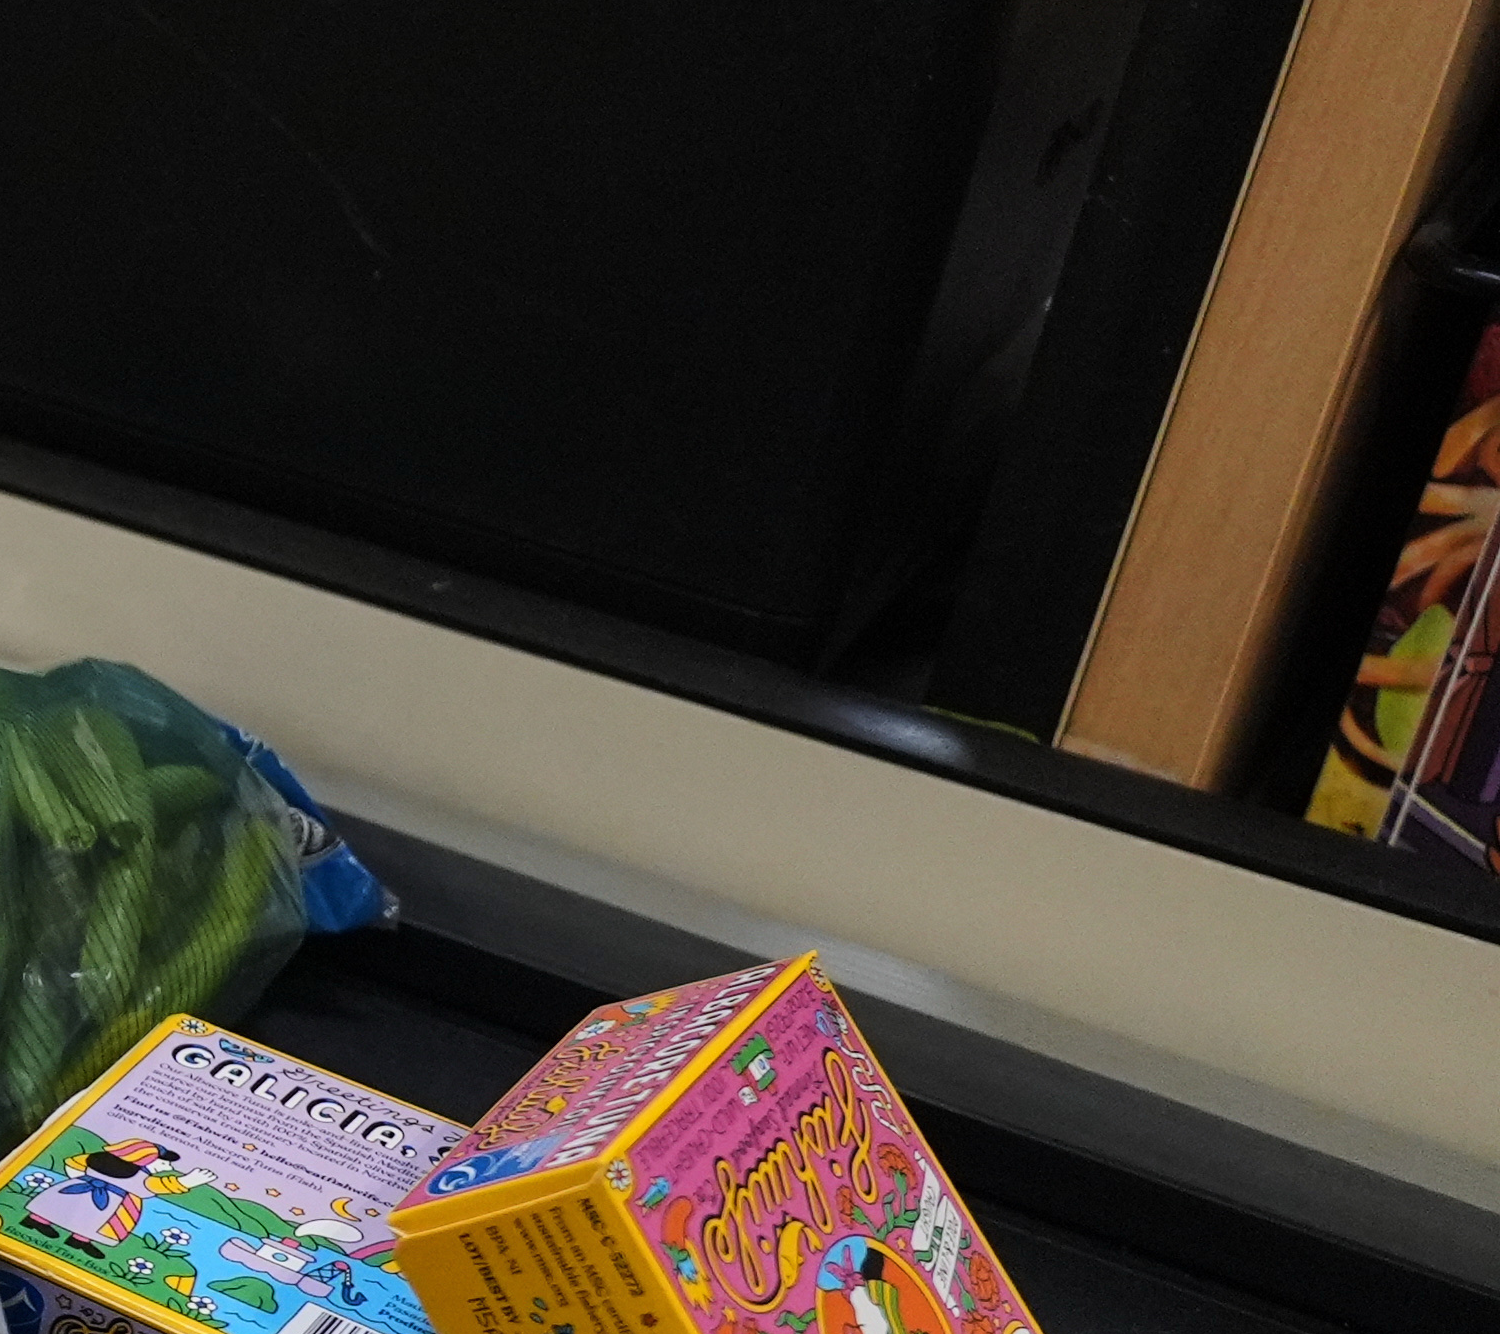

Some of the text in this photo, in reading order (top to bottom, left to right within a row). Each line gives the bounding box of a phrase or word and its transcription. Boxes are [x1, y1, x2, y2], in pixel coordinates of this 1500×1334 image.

[621, 966, 777, 1091] ALBACORE
[122, 1095, 155, 1111] Find
[172, 1113, 239, 1146] @Fishwife
[133, 1086, 277, 1149] the conservas tradition.
[152, 1069, 376, 1162] source our lemons from the Spanish
[159, 1062, 185, 1076] Our
[186, 1072, 241, 1098] Albacore
[241, 1094, 273, 1112] Tuna
[171, 1042, 418, 1159] GALICIA,
[278, 1065, 436, 1135] Greetings
[113, 1103, 324, 1195] Ingredients: Albacore Tuna (Fish),
[545, 1088, 655, 1168] TUNA
[259, 1148, 396, 1209] hello@eatfishwife.c
[704, 1047, 880, 1307] Fishwife
[458, 1232, 524, 1325] LOT/BEST BY
[530, 1211, 581, 1289] sustainable
